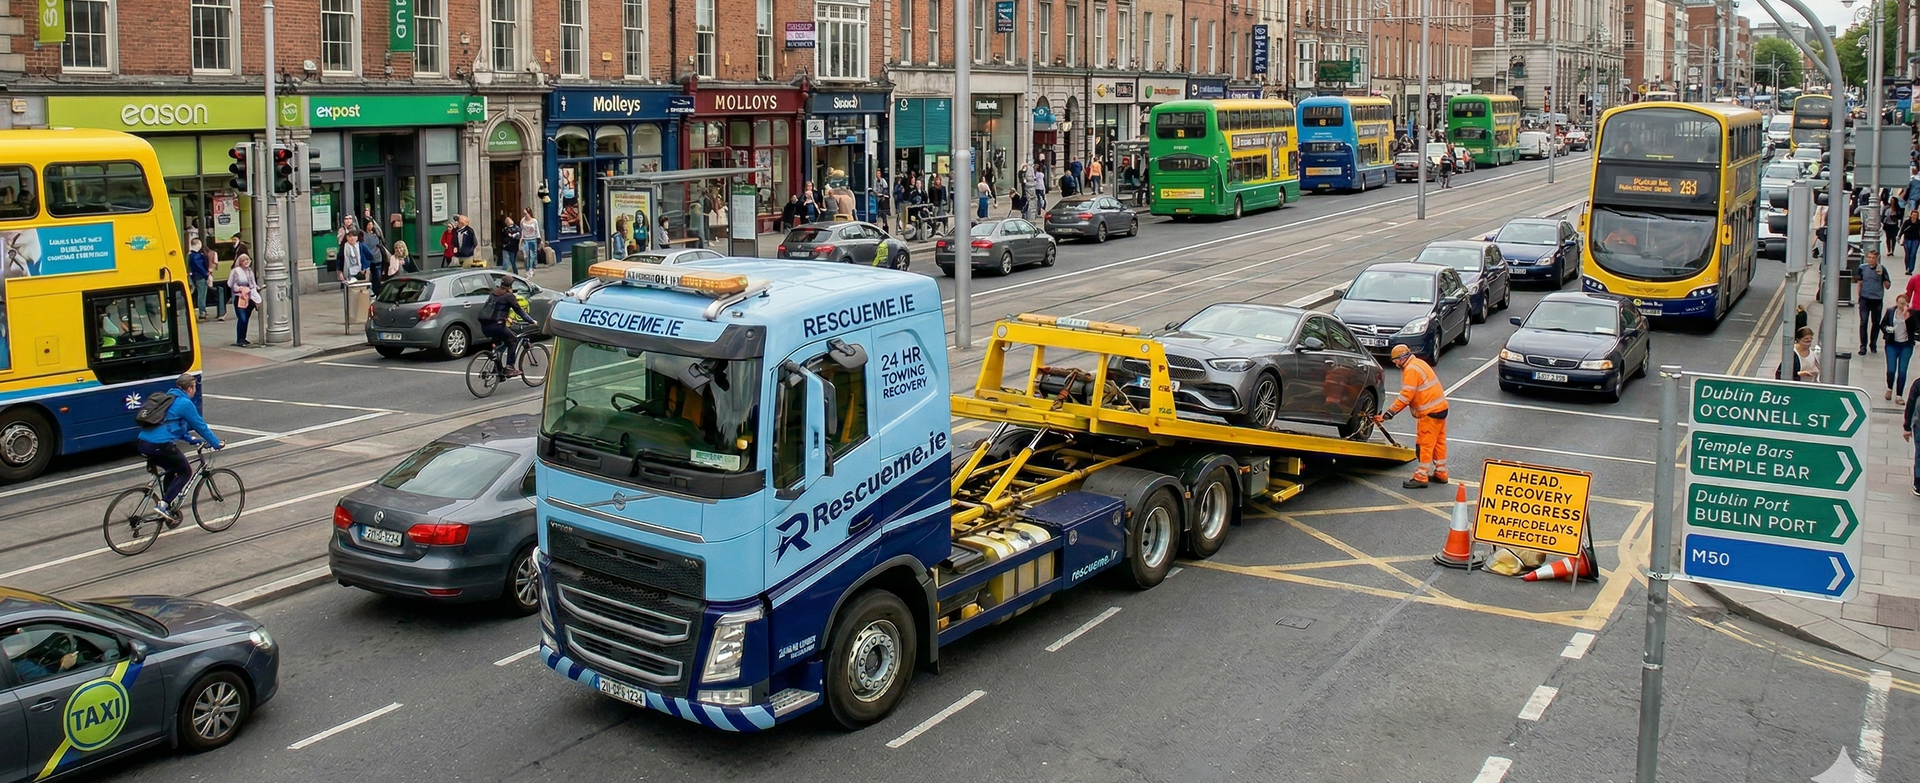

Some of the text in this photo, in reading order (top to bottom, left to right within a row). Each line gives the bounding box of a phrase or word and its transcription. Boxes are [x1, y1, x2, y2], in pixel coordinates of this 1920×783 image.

[593, 94, 641, 116] Molleys
[715, 94, 777, 110] MOLLOYS
[121, 103, 208, 126] eason
[578, 308, 684, 336] RESCUEME.IE
[803, 294, 916, 338] RESCUEME.IE
[881, 346, 922, 372] 24 HR
[882, 364, 925, 387] TOWING
[883, 376, 928, 399] RECOVERY
[1701, 385, 1791, 406] Dublin Bus
[1700, 404, 1831, 429] O'CONNELL ST
[1697, 437, 1794, 460] Temple Bars
[1697, 455, 1810, 481] TEMPLE BAR
[813, 431, 948, 534] Rescueme.ie
[1495, 484, 1573, 505] RECOVERY
[1695, 489, 1790, 513] Dublin Port
[1481, 497, 1581, 522] IN PROGRESS
[1484, 513, 1529, 529] TRAFFIC
[1695, 507, 1817, 534] BUBLIN PORT
[1497, 528, 1557, 546] AFFECTED
[1692, 548, 1730, 566] M50
[71, 697, 121, 732] TAXI
